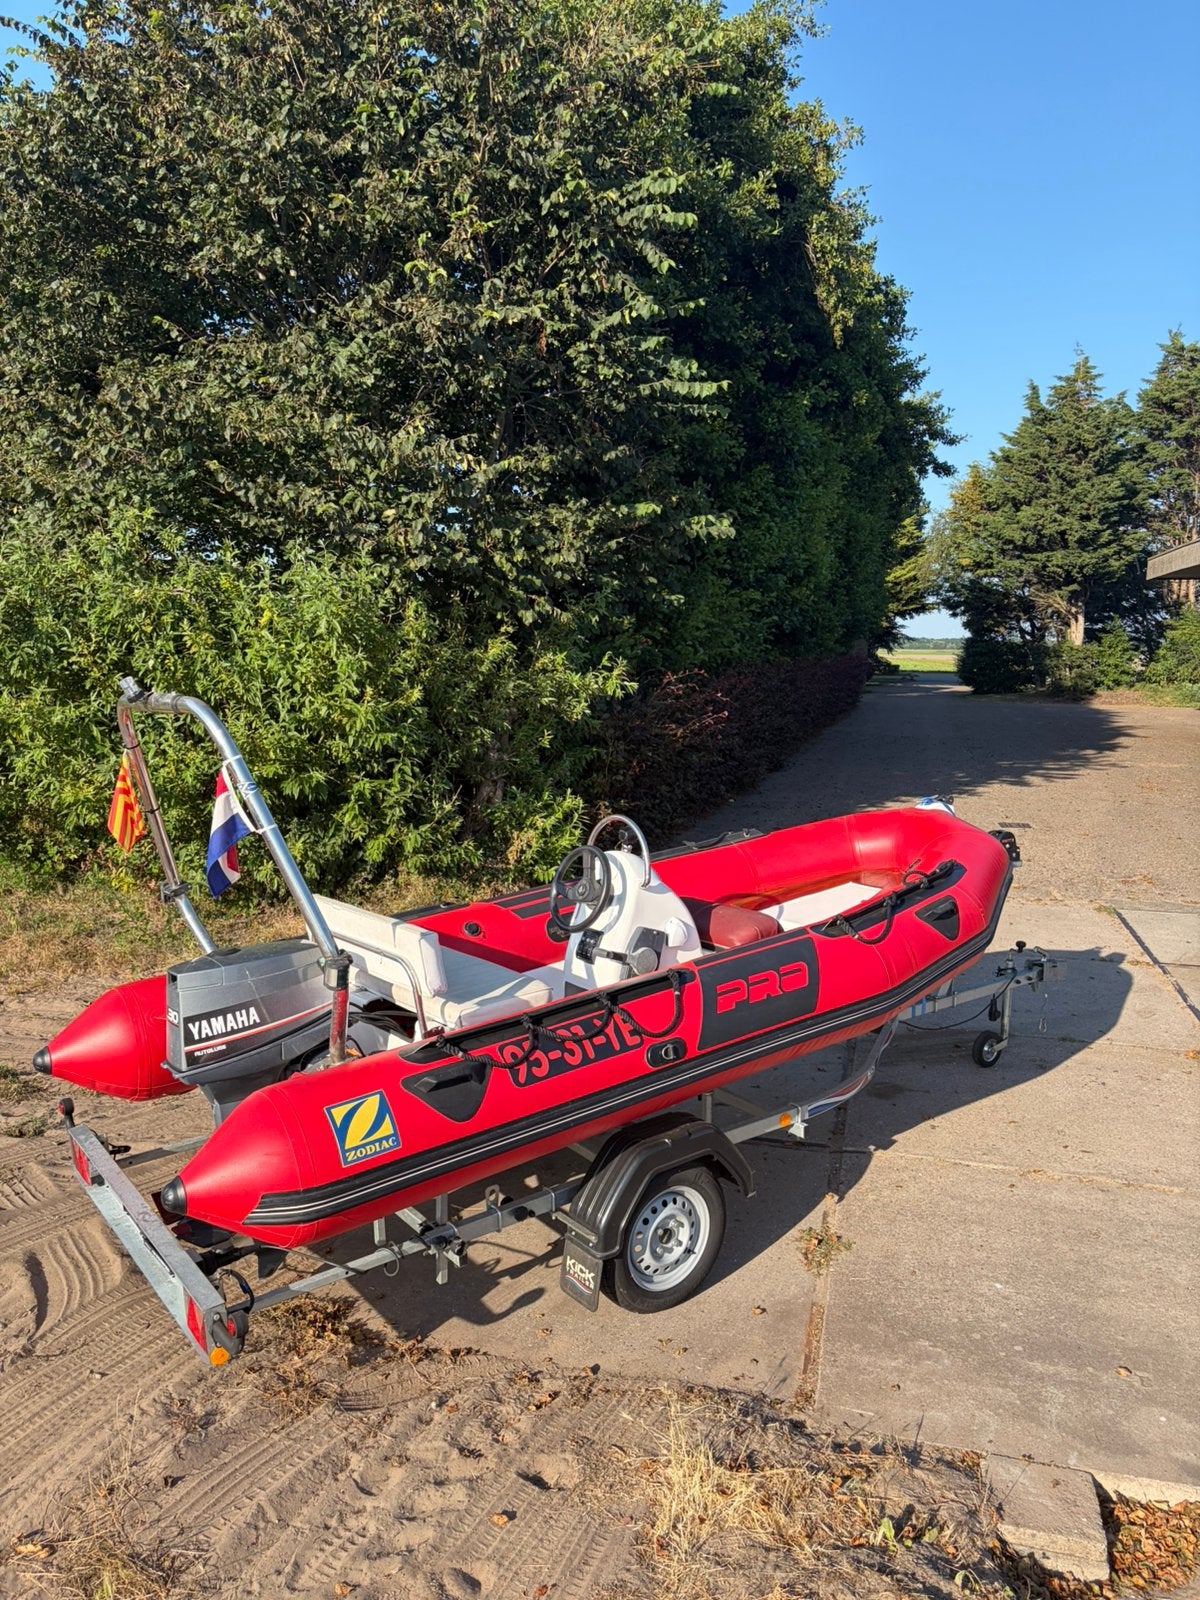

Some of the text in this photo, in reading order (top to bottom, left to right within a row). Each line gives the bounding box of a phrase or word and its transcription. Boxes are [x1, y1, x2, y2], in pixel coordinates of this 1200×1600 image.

[717, 961, 808, 1014] PRO
[167, 1008, 179, 1024] 30
[187, 1007, 260, 1040] YAMAHA
[345, 1136, 397, 1162] ZODIAC
[566, 1255, 595, 1284] KICK
